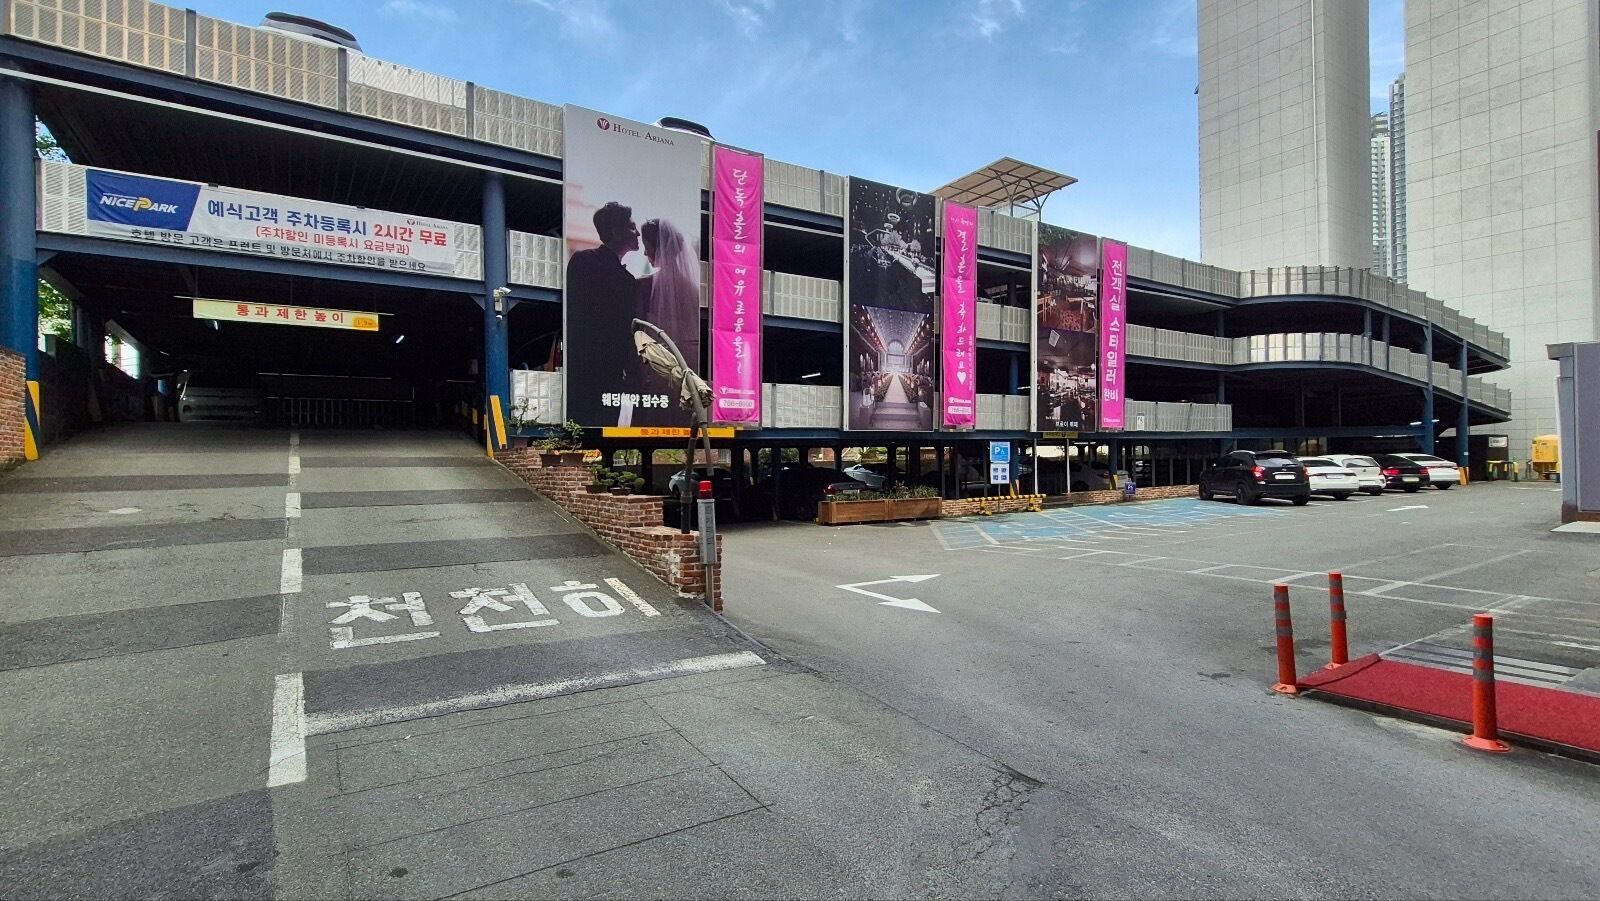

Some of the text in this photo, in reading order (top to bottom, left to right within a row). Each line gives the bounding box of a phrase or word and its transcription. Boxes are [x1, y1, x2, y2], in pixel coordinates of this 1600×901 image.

[207, 199, 447, 247] 예식고객 주차등록시 2시간 무료
[256, 225, 409, 256] (주차할인 미등록시 요금부과)
[131, 229, 426, 271] 호텔 방문 고객은 프런트 및 방문처에서 주차할인을 받으세요
[1104, 259, 1123, 401] 전객실 스타일러 완비
[601, 392, 669, 409] 웨딩예약 접수중
[325, 577, 662, 650] 천천히
